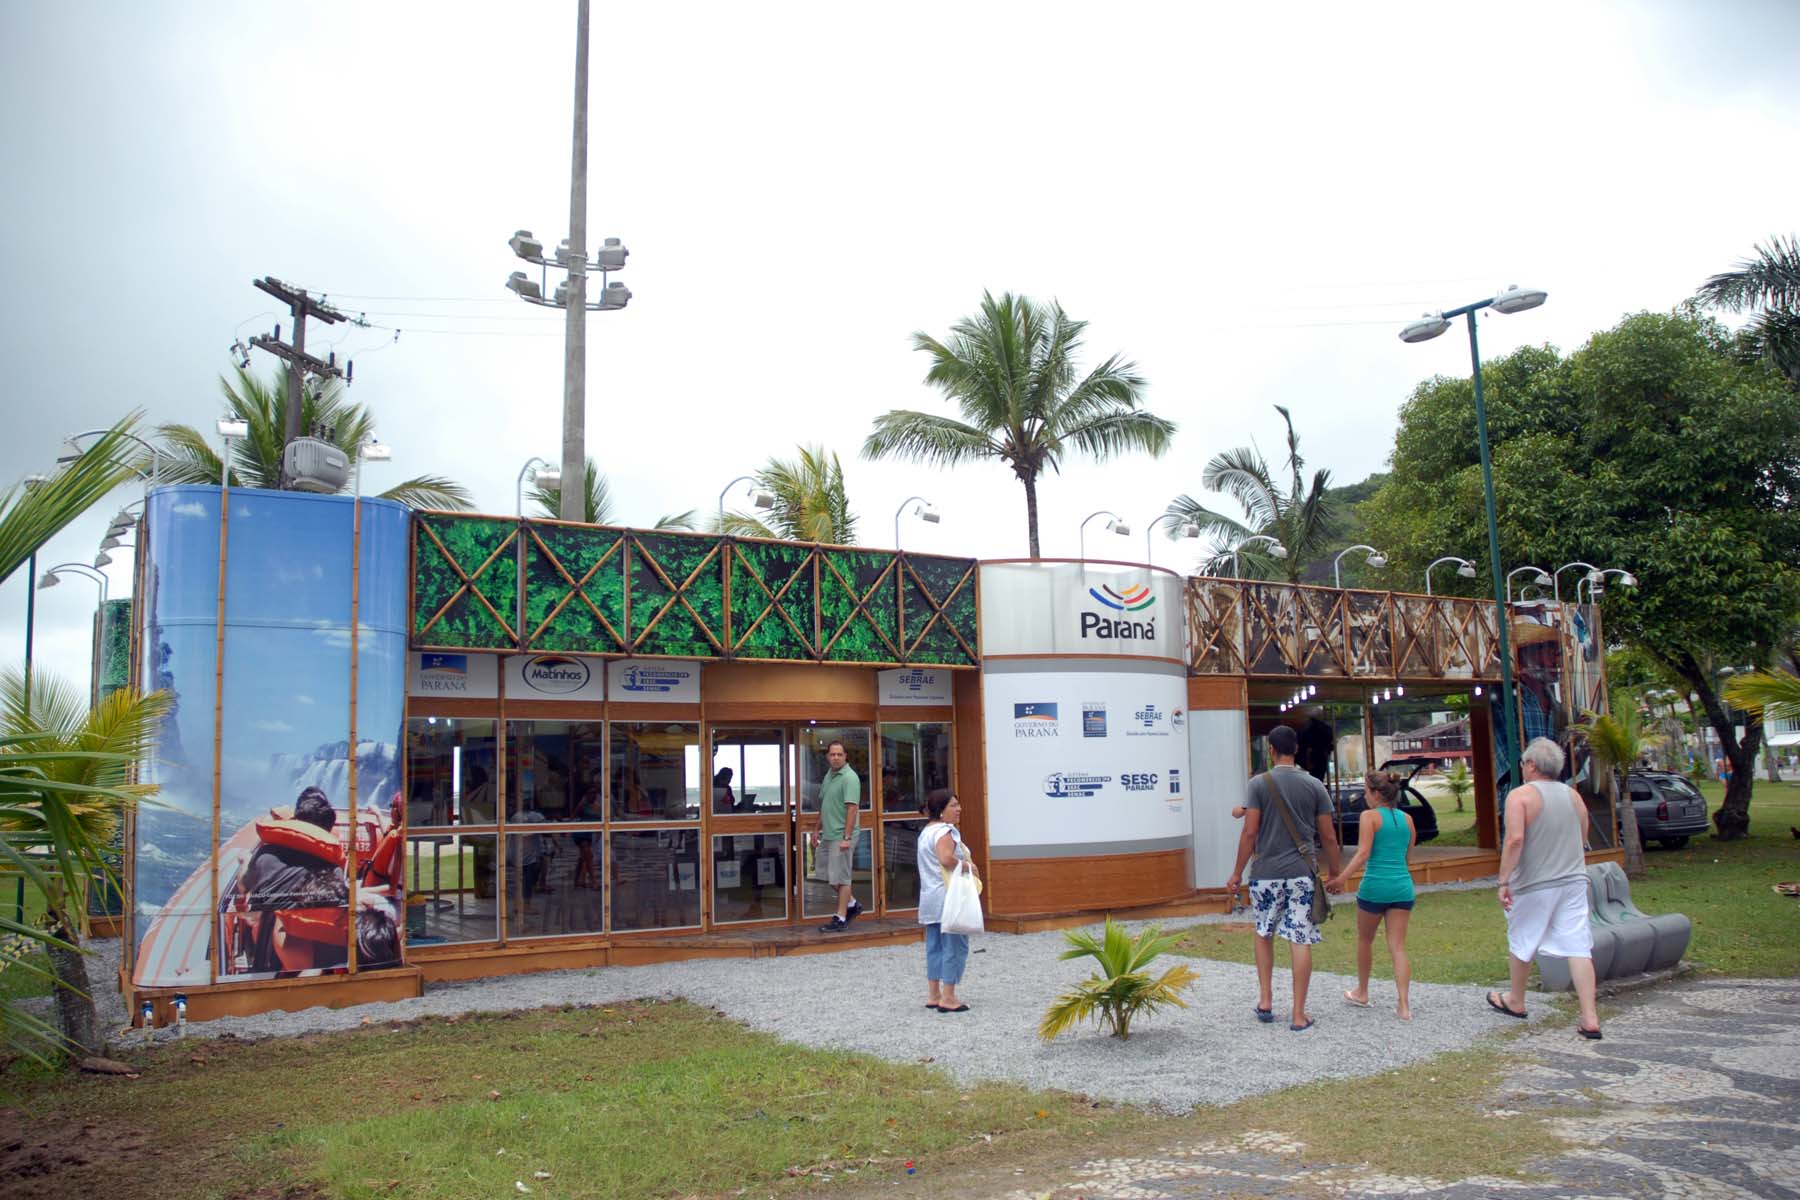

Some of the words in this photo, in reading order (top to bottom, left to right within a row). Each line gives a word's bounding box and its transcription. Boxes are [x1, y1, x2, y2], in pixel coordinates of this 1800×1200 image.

[1081, 612, 1155, 640] Paraná
[531, 669, 582, 681] Matinhos
[899, 676, 935, 684] SEBRAE
[1135, 711, 1163, 721] SEBRAE
[1121, 774, 1158, 785] SESC
